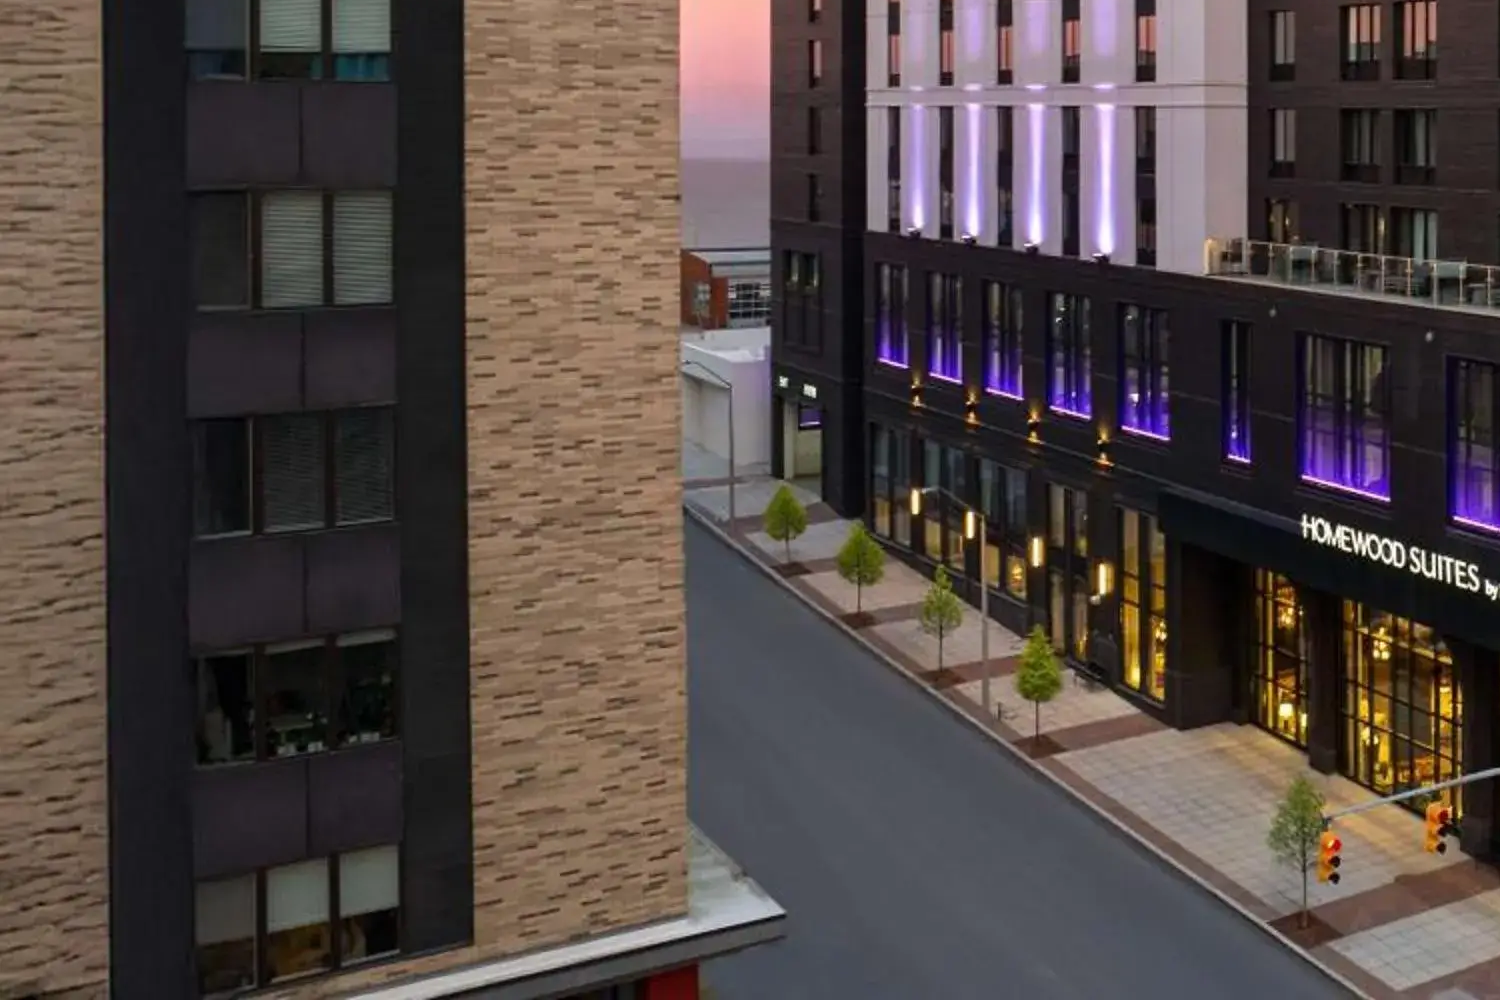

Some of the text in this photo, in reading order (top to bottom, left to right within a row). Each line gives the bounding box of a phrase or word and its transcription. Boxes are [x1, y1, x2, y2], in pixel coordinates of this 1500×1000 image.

[1301, 513, 1406, 569] HOMEWOOD
[1409, 546, 1480, 593] SUITES
[1485, 579, 1499, 601] by
